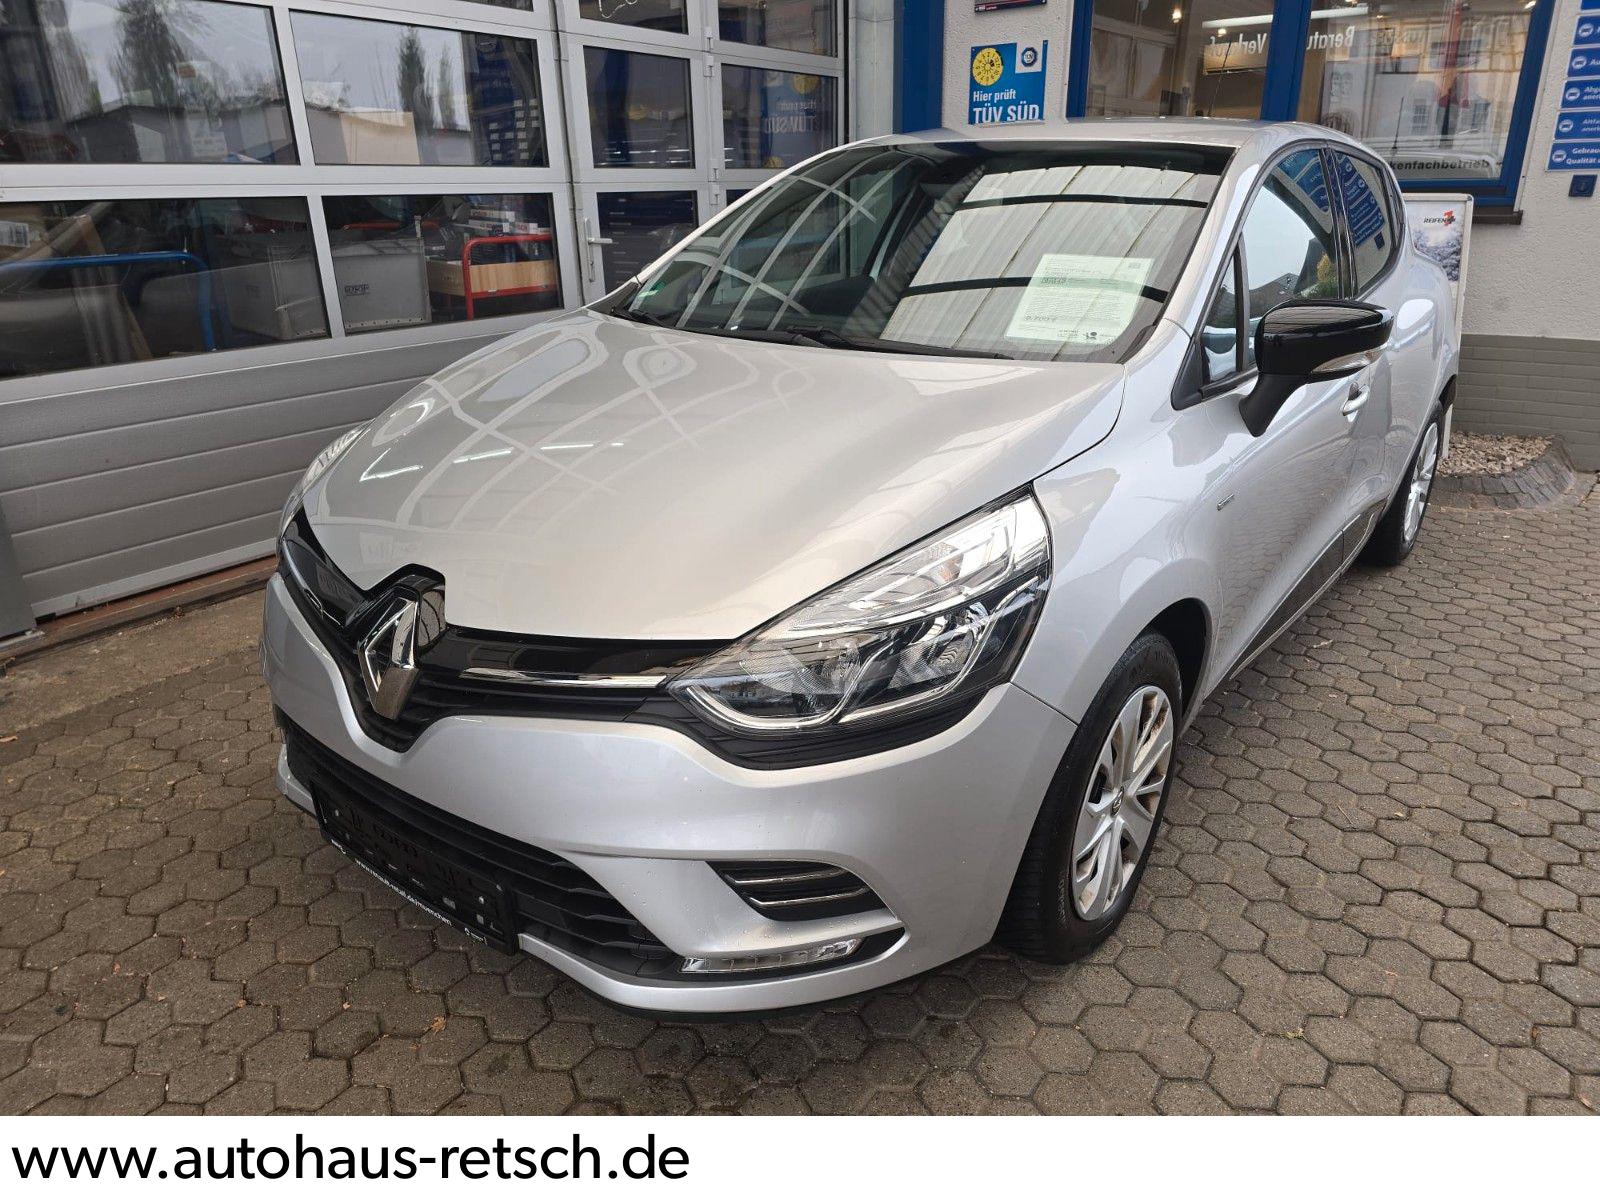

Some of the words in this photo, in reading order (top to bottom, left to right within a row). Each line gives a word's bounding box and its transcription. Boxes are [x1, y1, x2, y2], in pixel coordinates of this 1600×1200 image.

[973, 90, 992, 102] Hier
[994, 89, 1017, 103] prüft
[973, 103, 1003, 124] TÜV
[1006, 101, 1040, 122] SÜD
